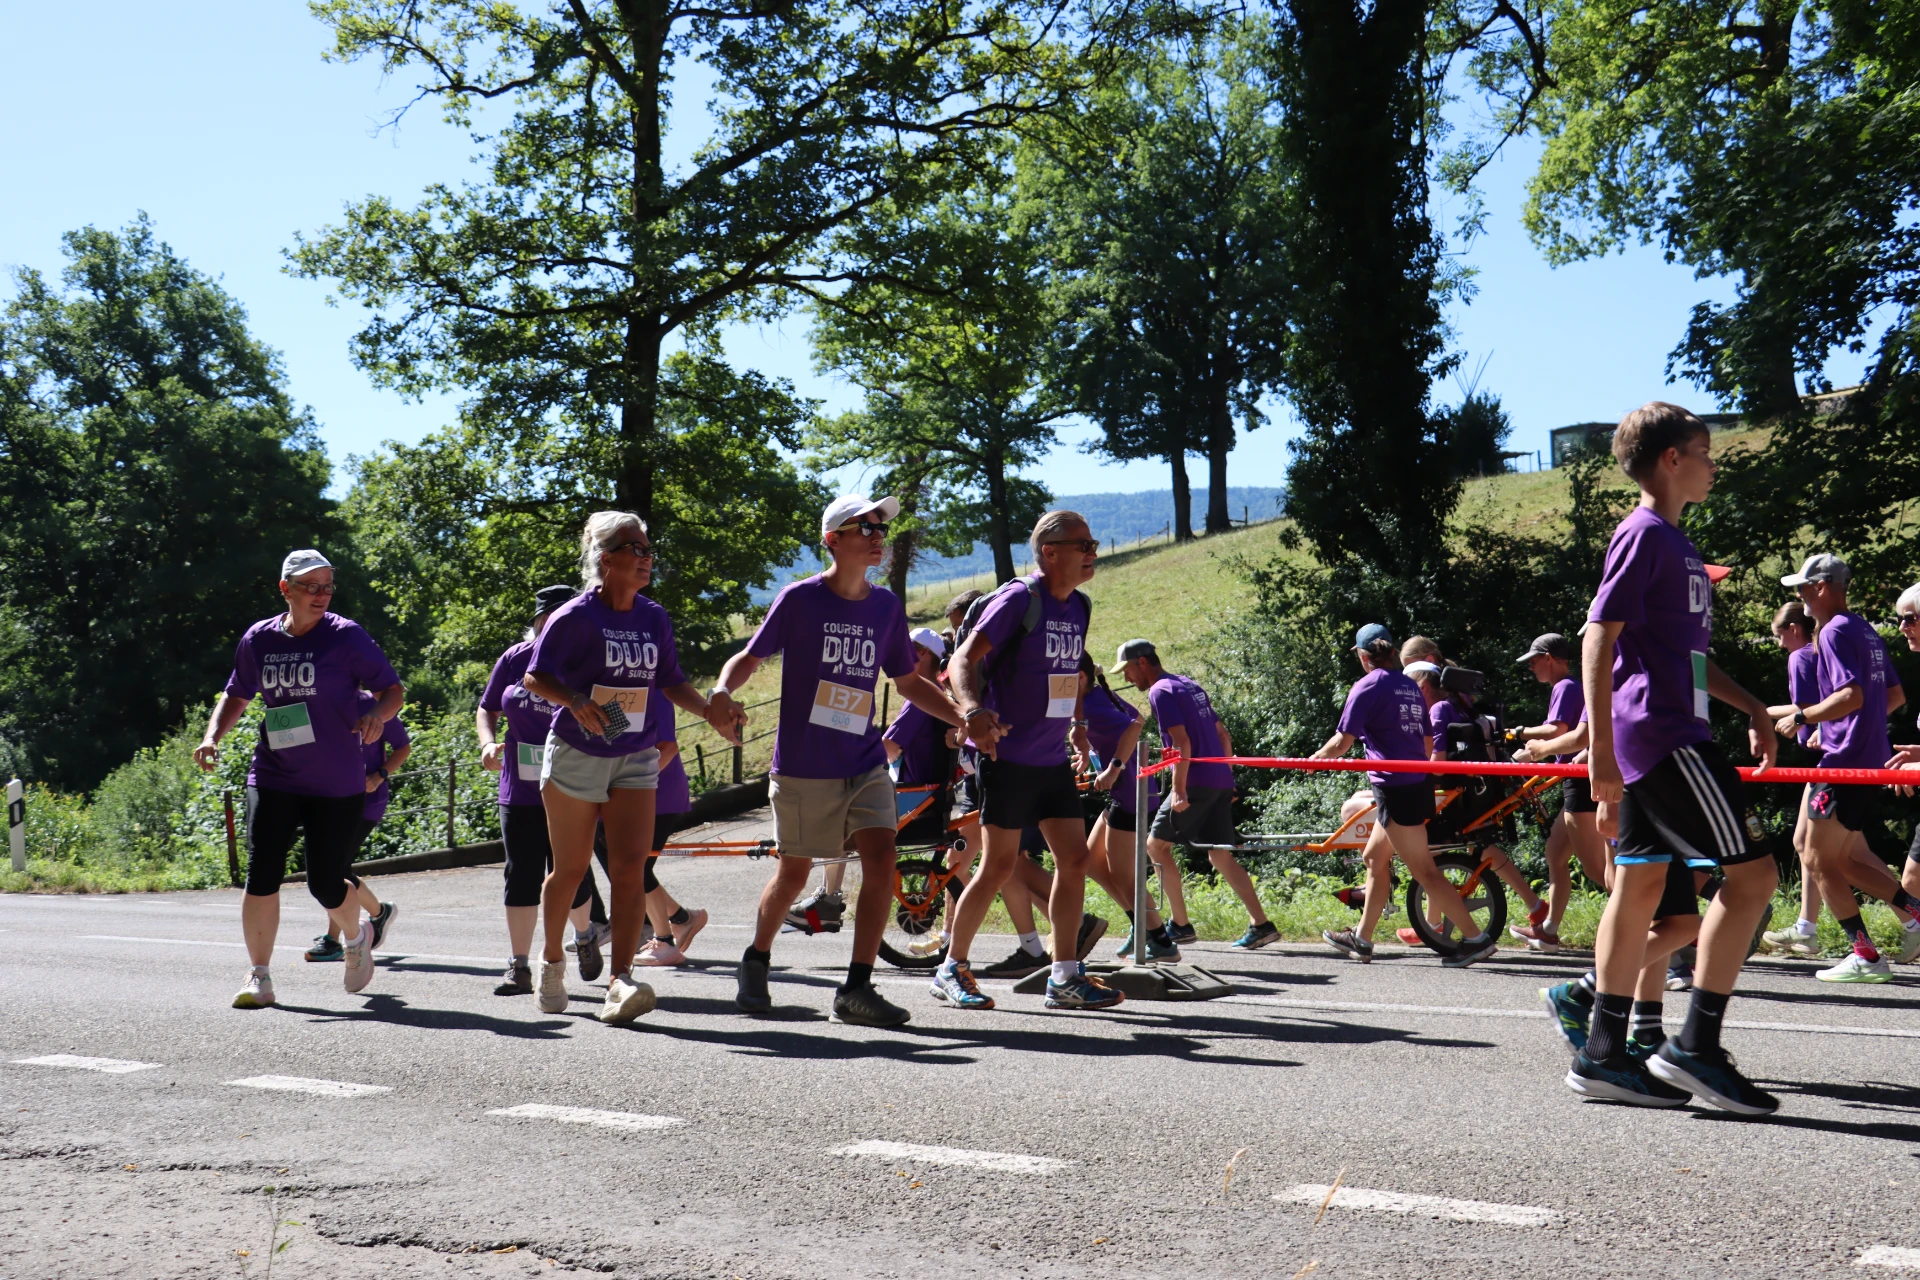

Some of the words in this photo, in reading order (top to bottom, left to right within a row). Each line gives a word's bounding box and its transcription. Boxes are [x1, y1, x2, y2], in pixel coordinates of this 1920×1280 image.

[1689, 574, 1713, 616] DU
[603, 628, 640, 641] COURSE
[823, 622, 864, 636] COURSE
[822, 635, 876, 668] DUO
[1045, 632, 1083, 660] DUO
[264, 652, 302, 663] COURSE
[605, 640, 658, 670] DUO
[262, 662, 316, 689] DUO
[627, 669, 656, 680] SUISSE
[846, 666, 874, 678] SUISSE
[288, 687, 318, 697] SUISSE
[828, 686, 863, 712] 137
[533, 703, 556, 716] SUISS
[273, 711, 291, 728] 10
